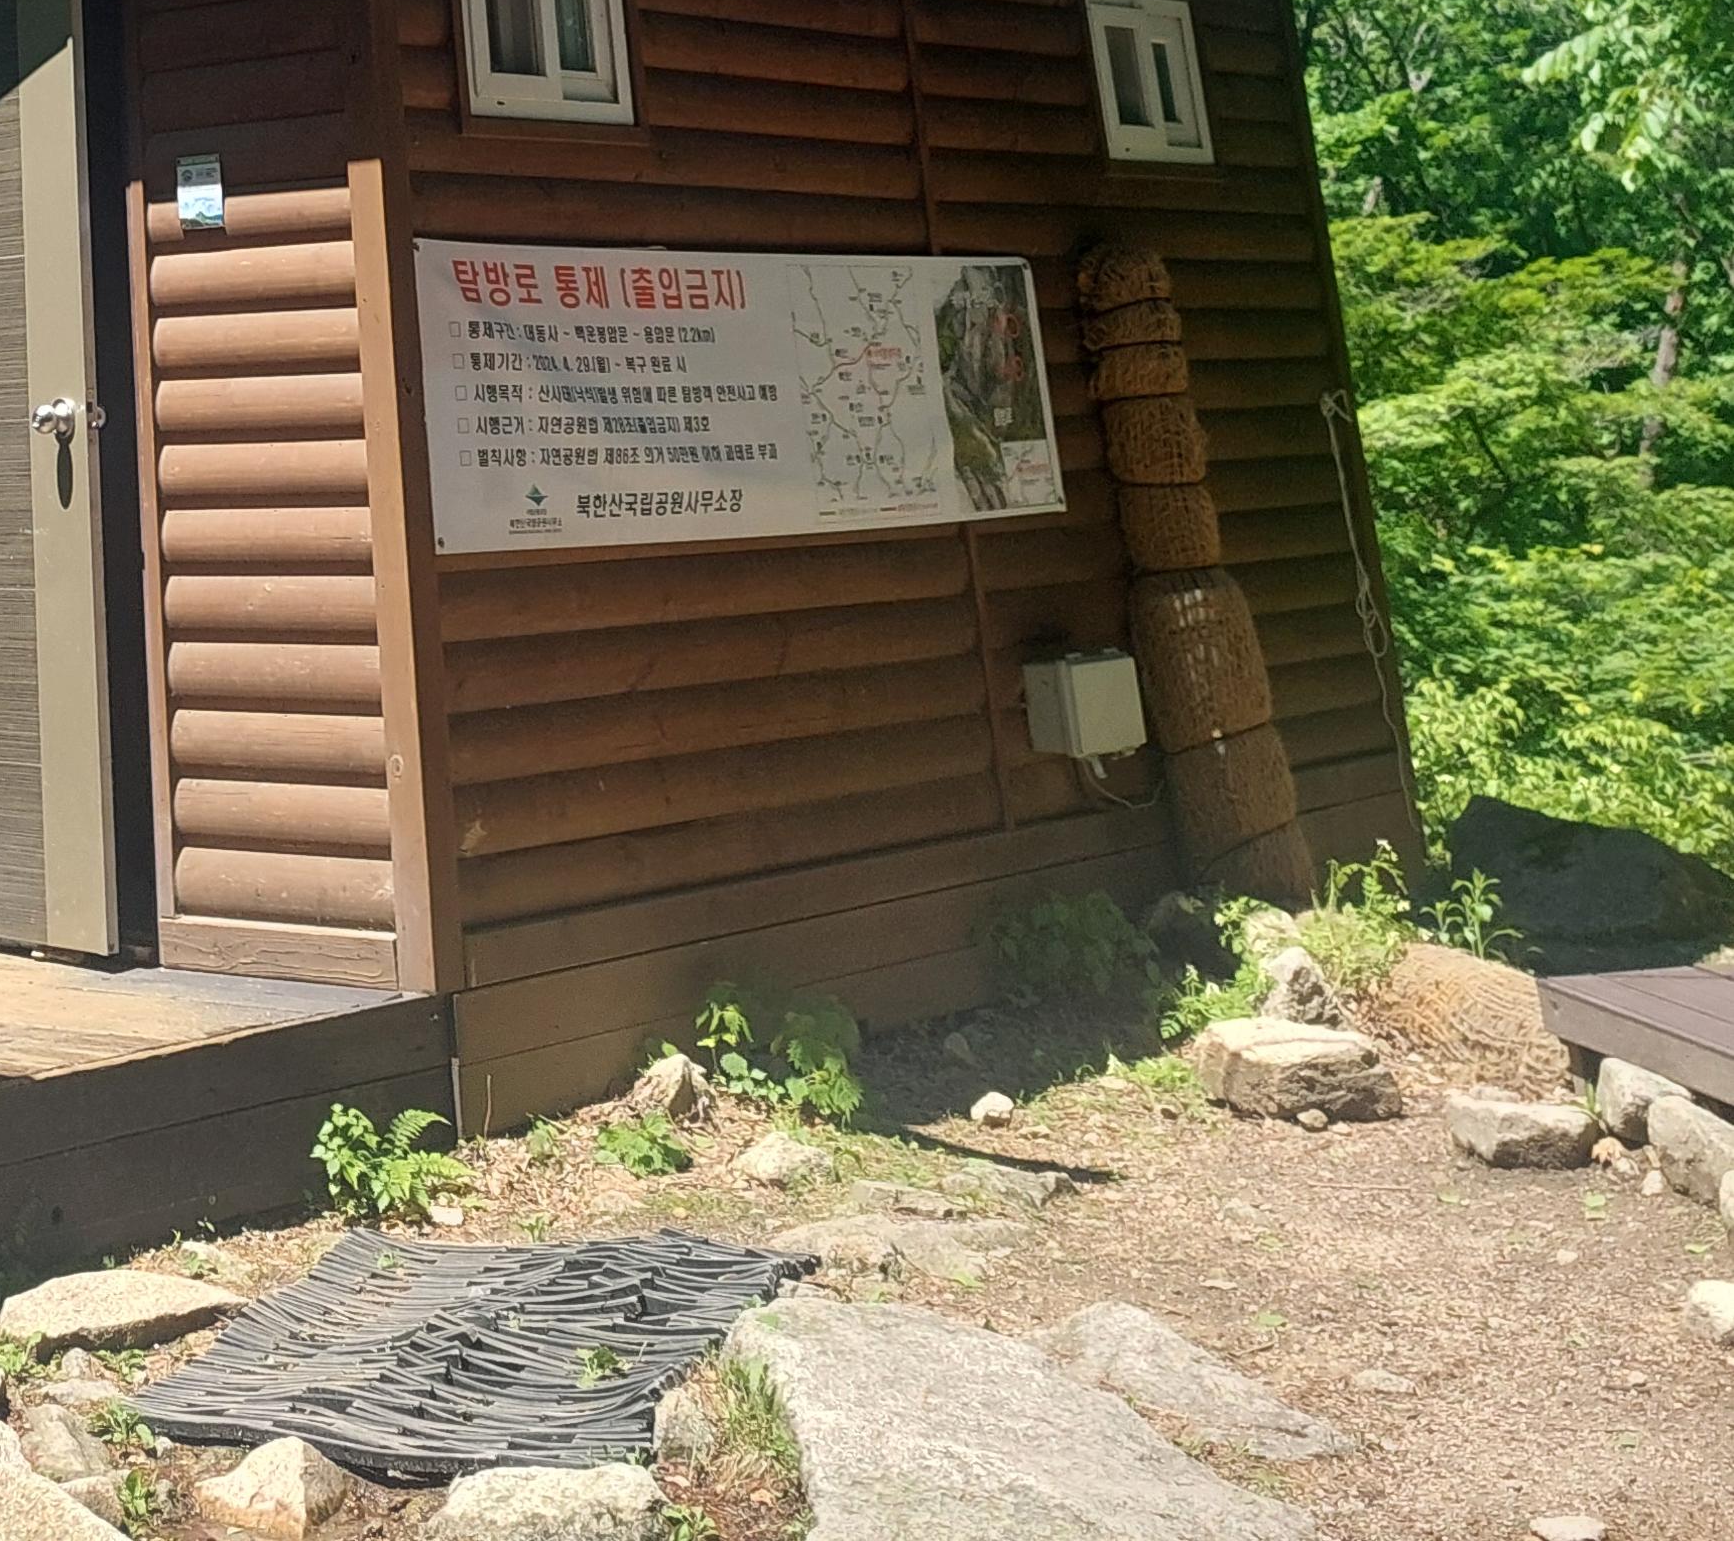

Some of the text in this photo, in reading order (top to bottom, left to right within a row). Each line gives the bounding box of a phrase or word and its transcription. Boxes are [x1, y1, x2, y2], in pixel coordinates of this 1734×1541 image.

[451, 260, 747, 311] 탐방로 통제 (출입금지)
[467, 320, 515, 340] 통제구간
[523, 323, 559, 343] 대동사
[644, 325, 675, 344] 용암문
[469, 352, 523, 371] 통제기간
[625, 356, 647, 373] 복구
[650, 356, 672, 373] 완료
[676, 356, 688, 373] 시
[474, 384, 523, 403] 시행목적
[621, 386, 653, 404] 위험에
[656, 386, 678, 403] 따른
[681, 386, 714, 403] 탐방객
[716, 385, 756, 402] 안전사고
[758, 384, 778, 401] 예방
[475, 416, 525, 435] 시행근거
[537, 416, 599, 435] 자연공원법
[683, 415, 710, 433] 제3호
[477, 448, 527, 468] 벌칙사항
[539, 447, 598, 466] 자연공원법
[644, 445, 665, 464] 의거
[724, 444, 755, 461] 과태료
[758, 443, 778, 460] 부과
[576, 489, 743, 518] 북한산국립공원사무소장
